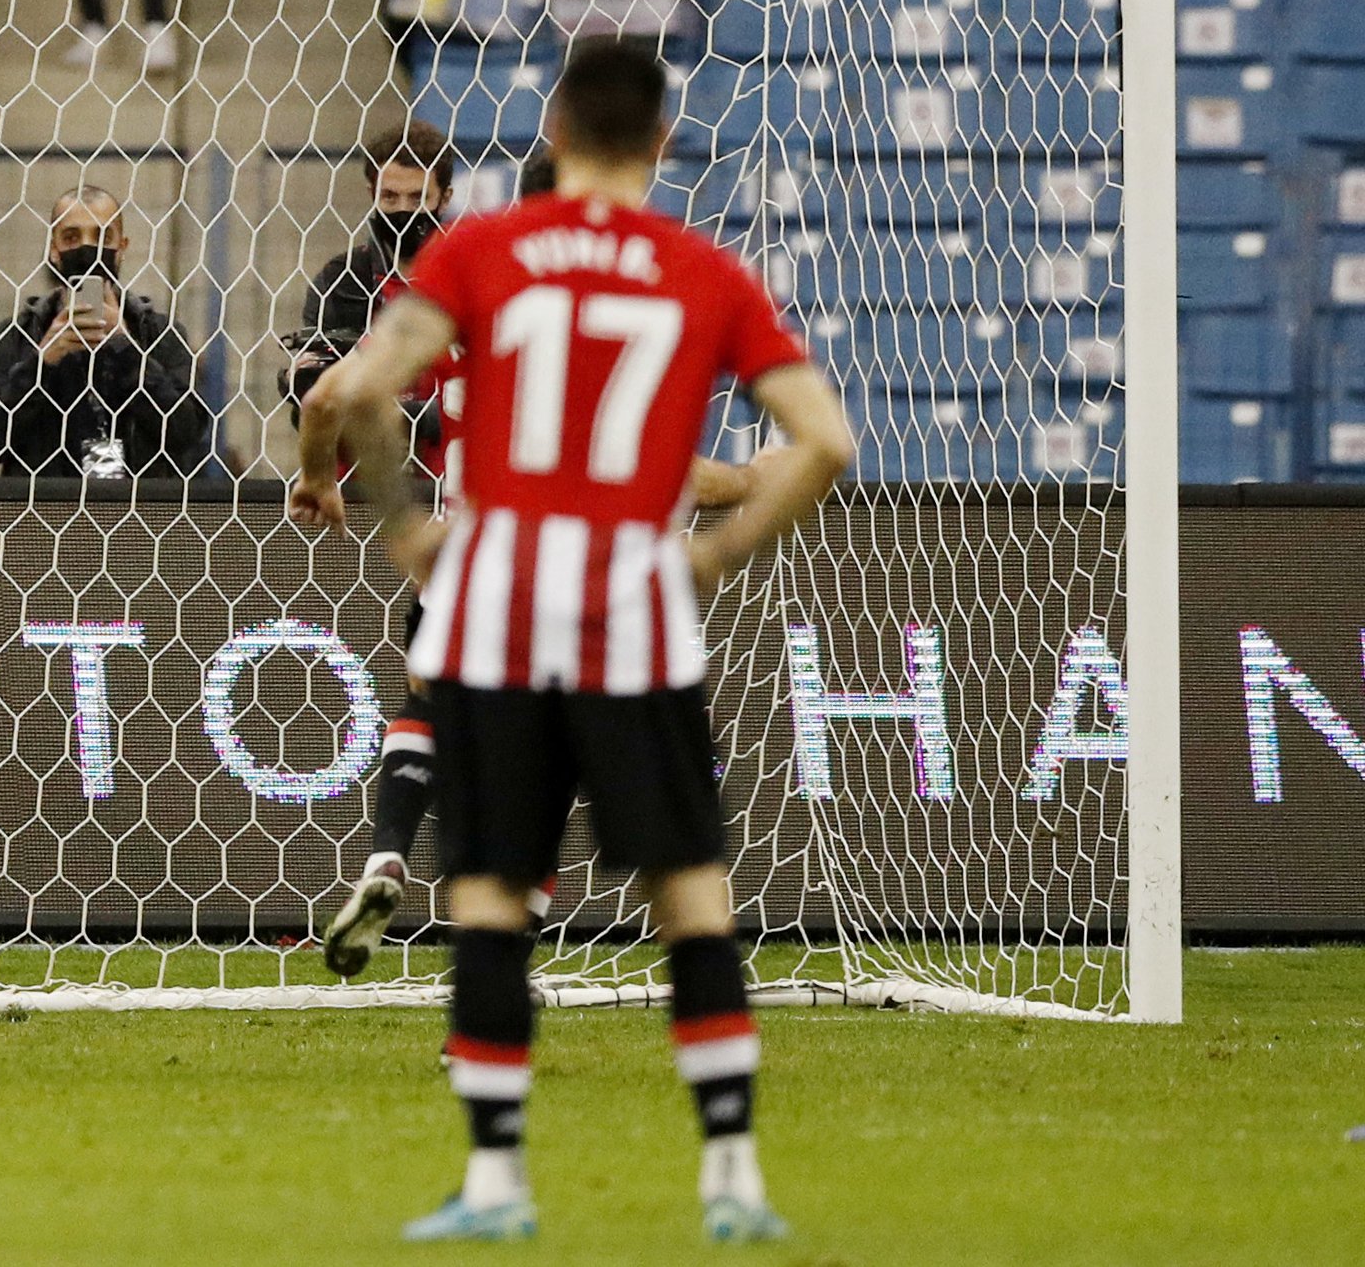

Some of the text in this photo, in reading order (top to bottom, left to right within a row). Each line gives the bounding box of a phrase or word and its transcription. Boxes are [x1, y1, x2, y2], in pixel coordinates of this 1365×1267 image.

[490, 284, 685, 485] 17
[21, 617, 381, 804] TO
[694, 622, 1365, 804] HAN
